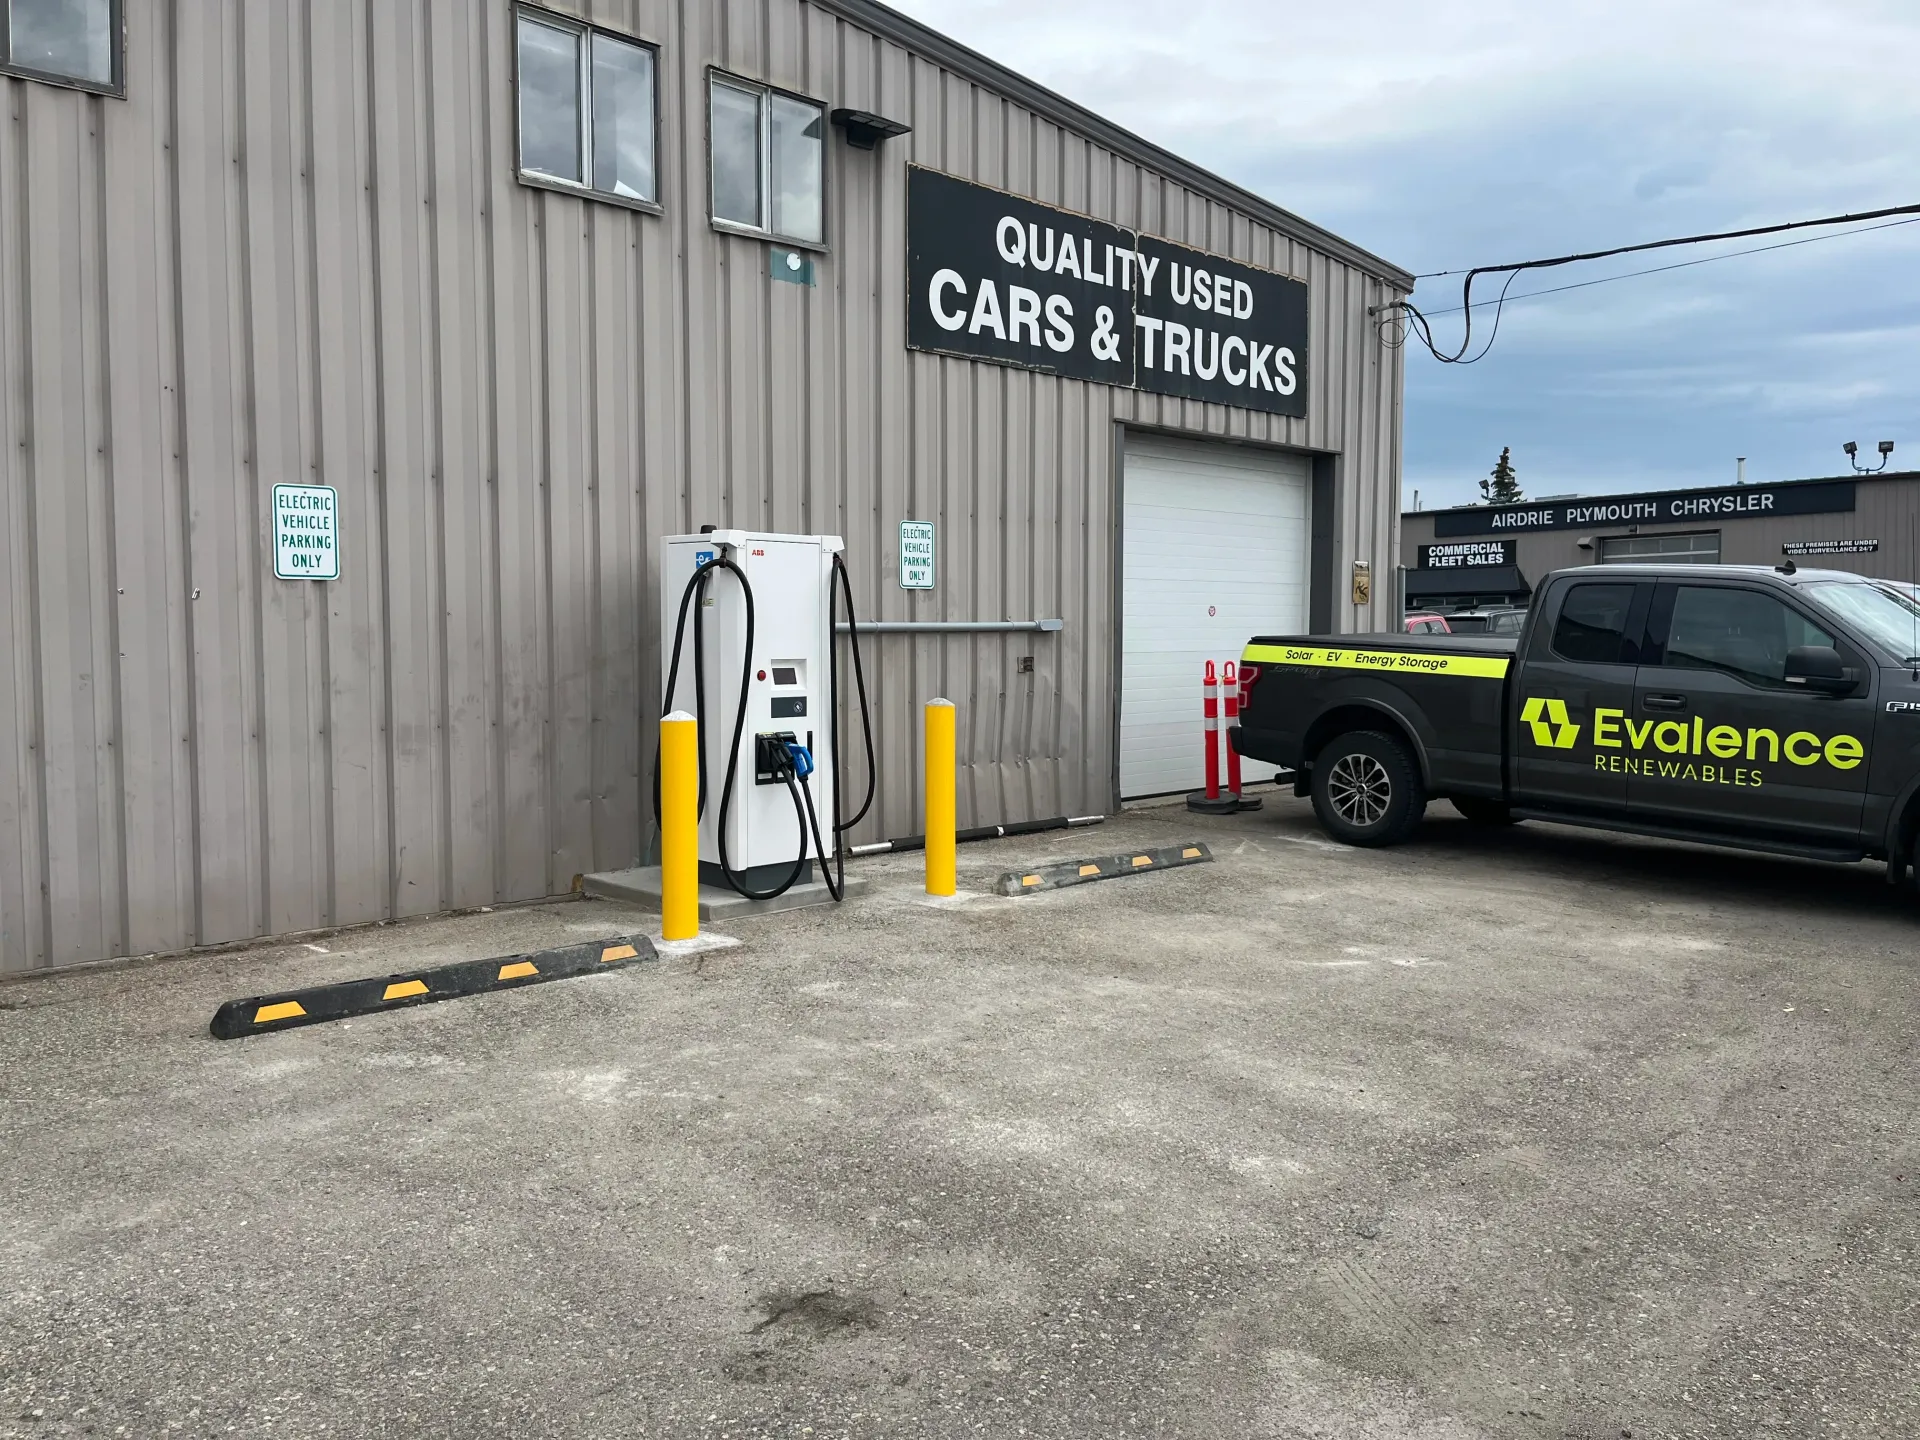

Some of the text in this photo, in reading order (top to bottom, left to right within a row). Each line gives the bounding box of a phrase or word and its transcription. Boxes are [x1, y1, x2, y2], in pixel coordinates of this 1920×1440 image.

[996, 215, 1254, 320] QUALITY USED
[928, 268, 1297, 396] CARS & TRUCKS
[279, 494, 331, 510] ELECTRIC
[1491, 493, 1774, 528] AIRDRIE PLYMOUTH CHRYSLER
[282, 514, 330, 530] VEHICLE
[281, 533, 331, 549] PARKING
[903, 528, 931, 540] ELECTRIC
[751, 549, 765, 557] ABB
[904, 542, 930, 553] VEHICLE
[1428, 542, 1504, 556] COMMERCIAL
[1808, 546, 1857, 554] SURVEILLANCE
[292, 553, 322, 568] ONLY
[903, 556, 931, 567] PARKING
[1428, 553, 1504, 567] FLEET SALES
[908, 570, 925, 581] ONLY
[1285, 649, 1448, 670] Solar EV Energy Storage
[1593, 707, 1864, 770] Evalence
[1595, 754, 1763, 787] RENEWABLES
